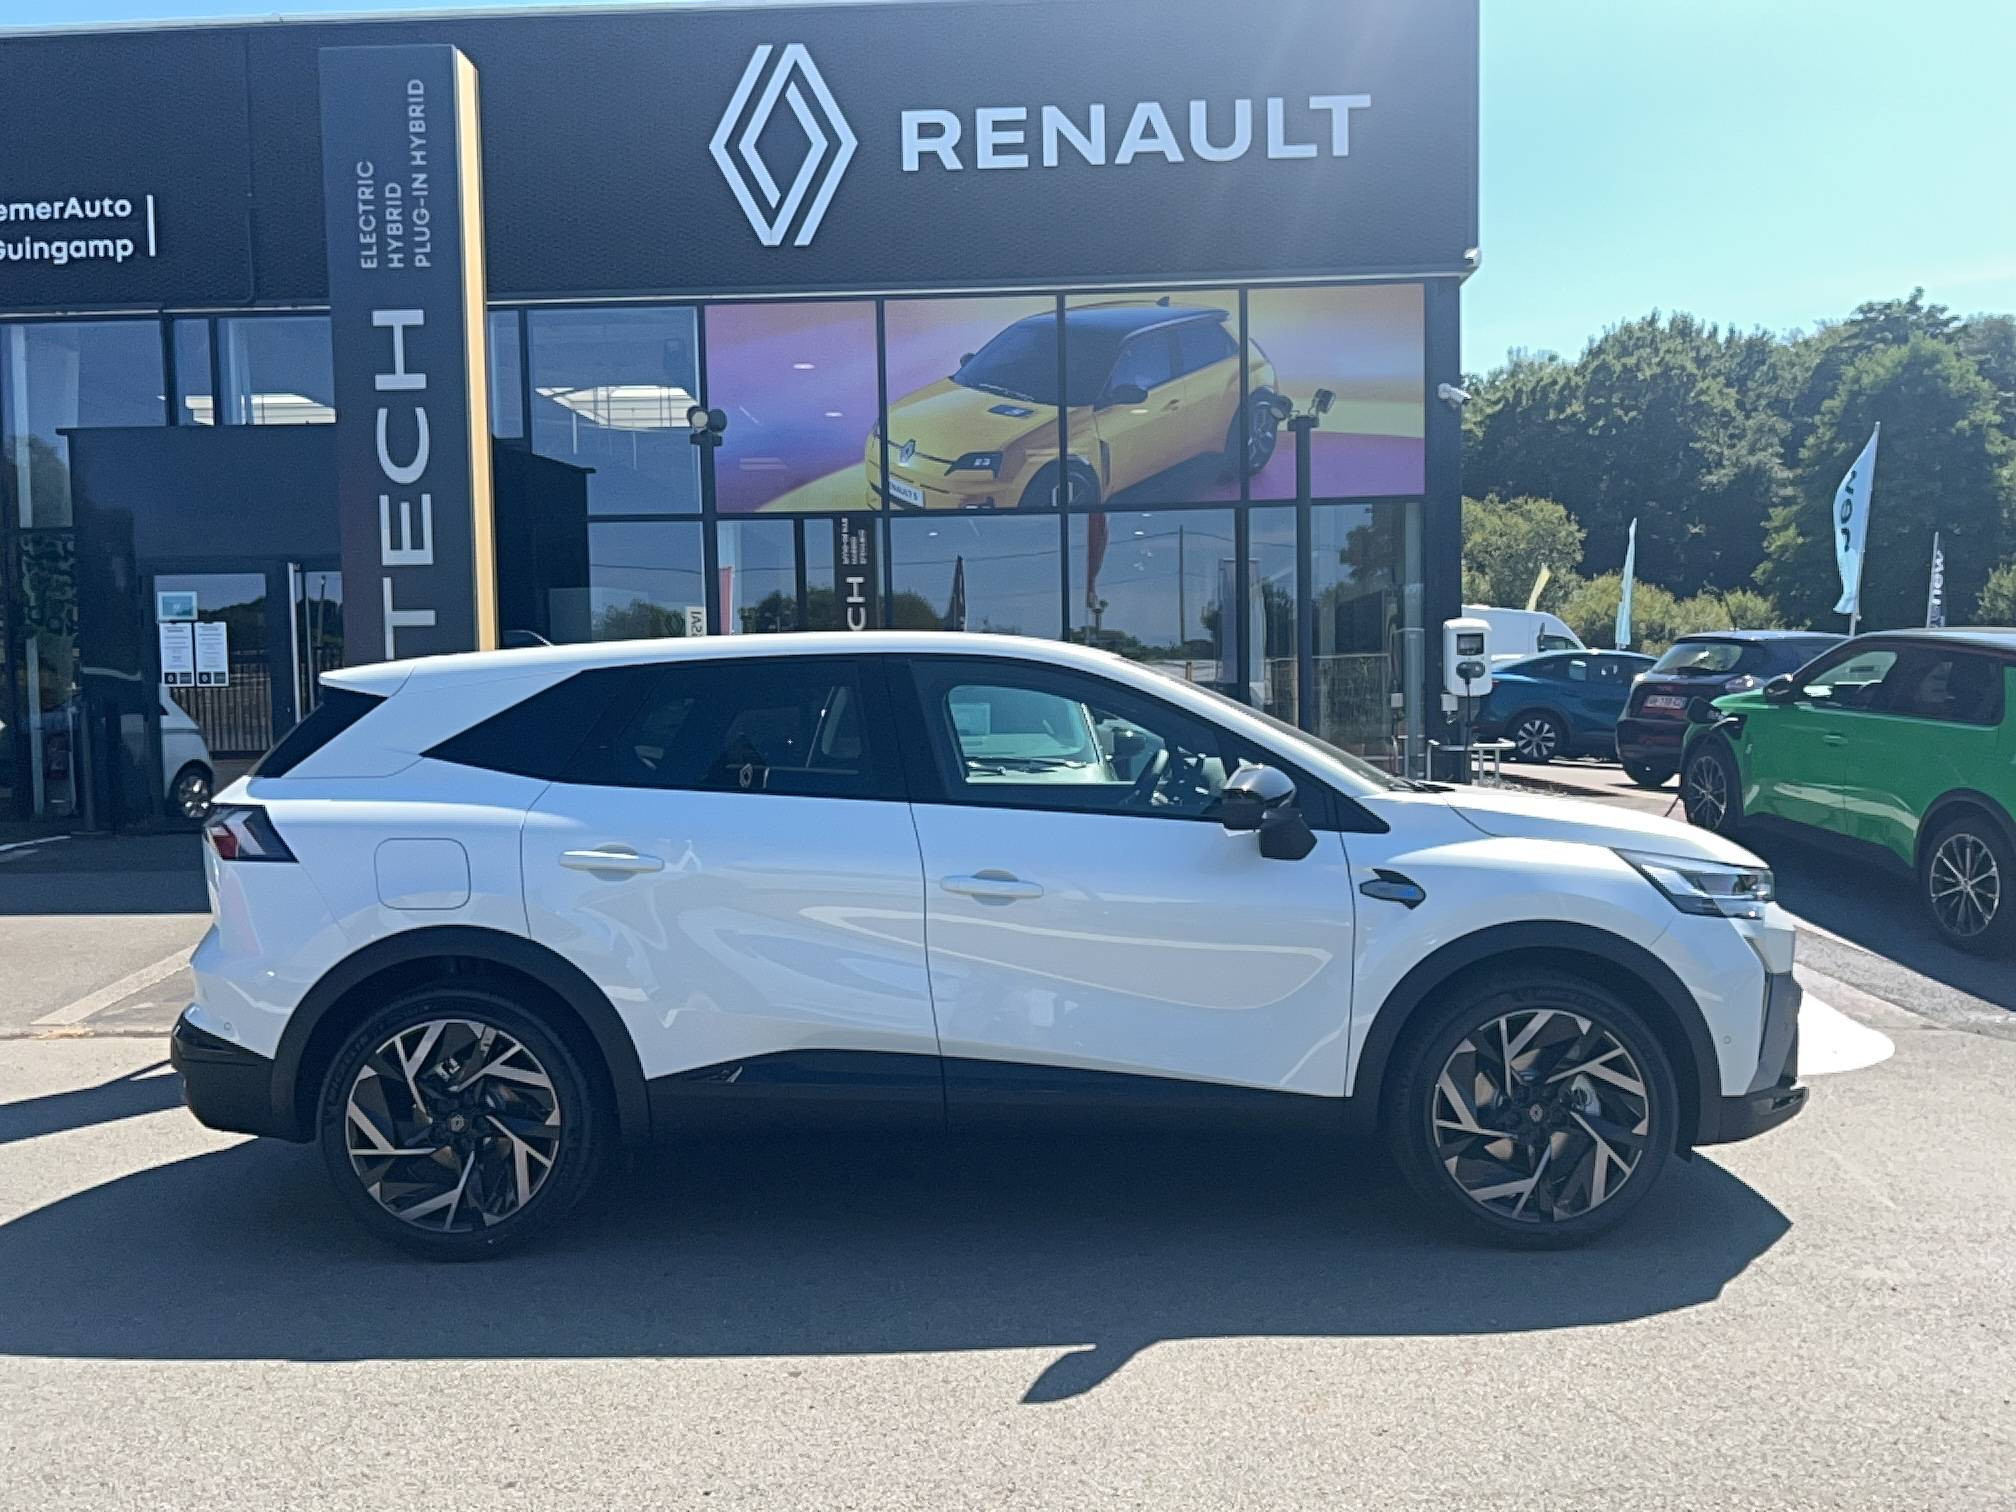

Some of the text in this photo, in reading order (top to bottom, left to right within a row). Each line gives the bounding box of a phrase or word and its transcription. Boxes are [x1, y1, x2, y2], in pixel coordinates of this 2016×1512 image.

[407, 79, 431, 268] PLUG-IN HYBRID
[901, 94, 1371, 171] RENAULT
[357, 160, 377, 269] ELECTRIC
[385, 182, 404, 268] HYBRID
[371, 308, 436, 660] TECH
